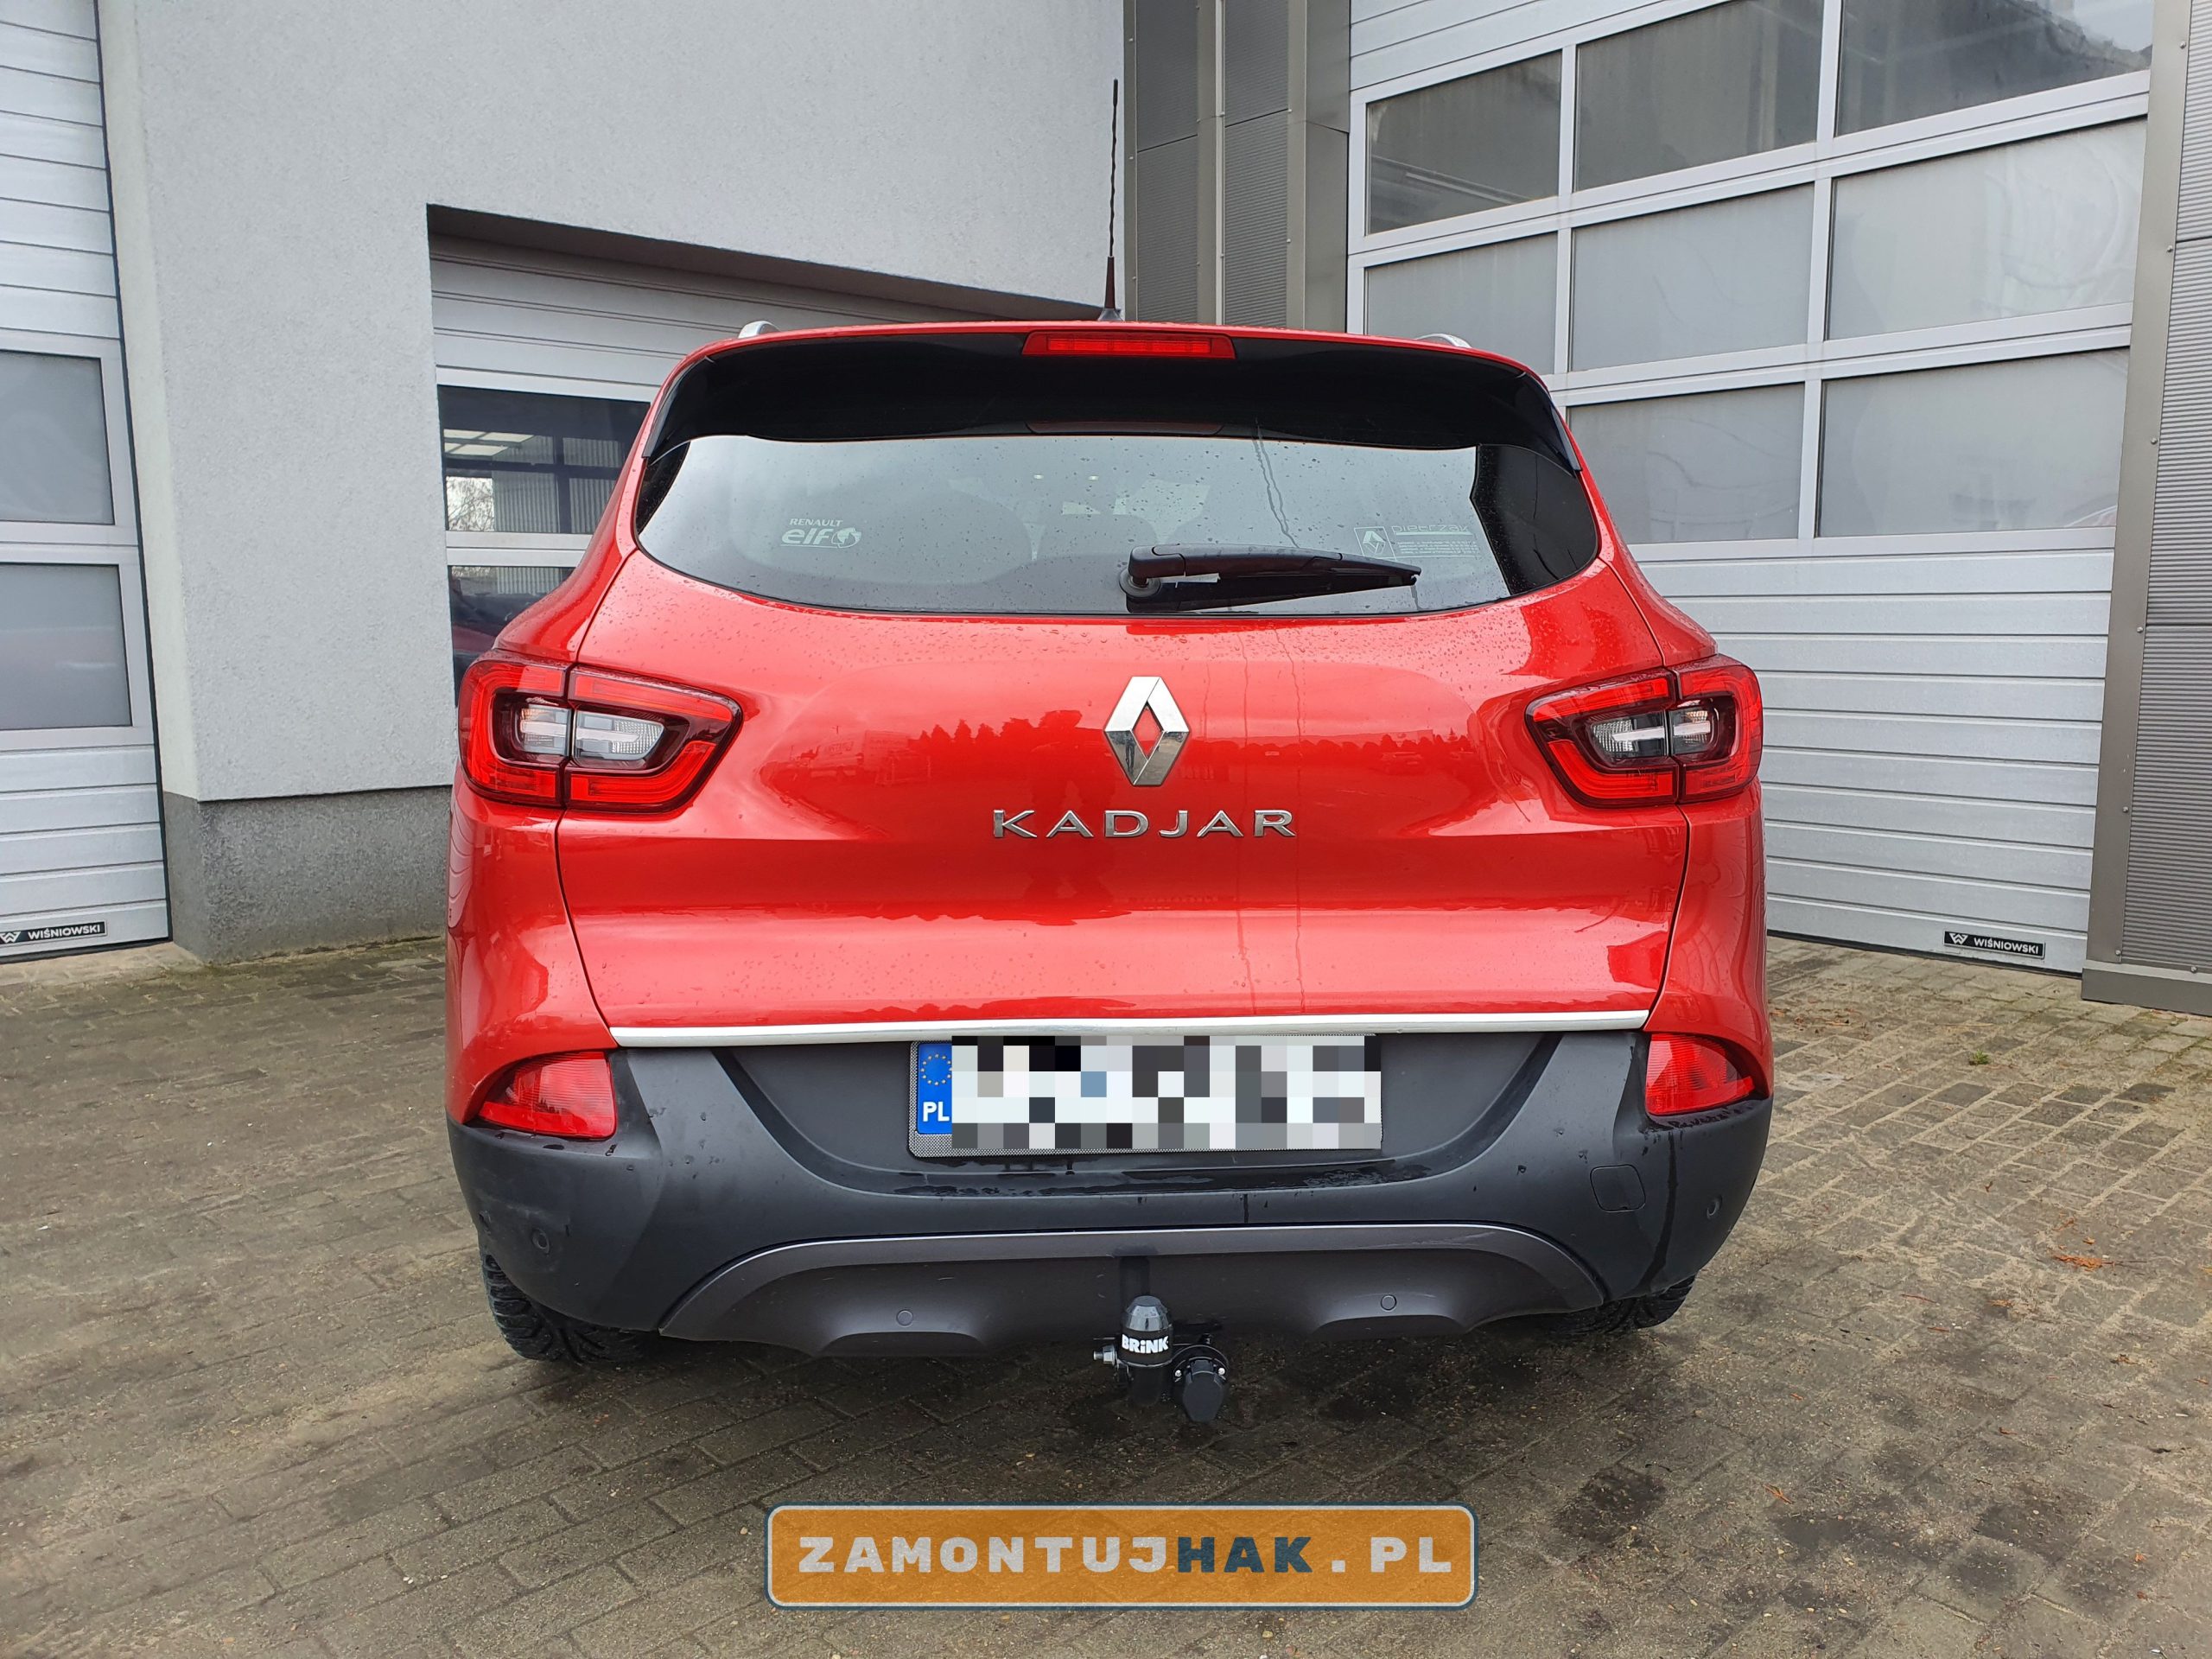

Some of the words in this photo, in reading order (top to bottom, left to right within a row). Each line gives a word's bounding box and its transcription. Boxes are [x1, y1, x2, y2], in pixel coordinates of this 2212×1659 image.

[789, 518, 843, 527] RENAULT
[781, 528, 835, 545] elf
[993, 810, 1296, 838] KADJAR
[28, 924, 101, 940] WIŚNIOWSKI
[1974, 937, 2039, 955] WIŚNIOWSKI
[922, 1101, 950, 1122] PL
